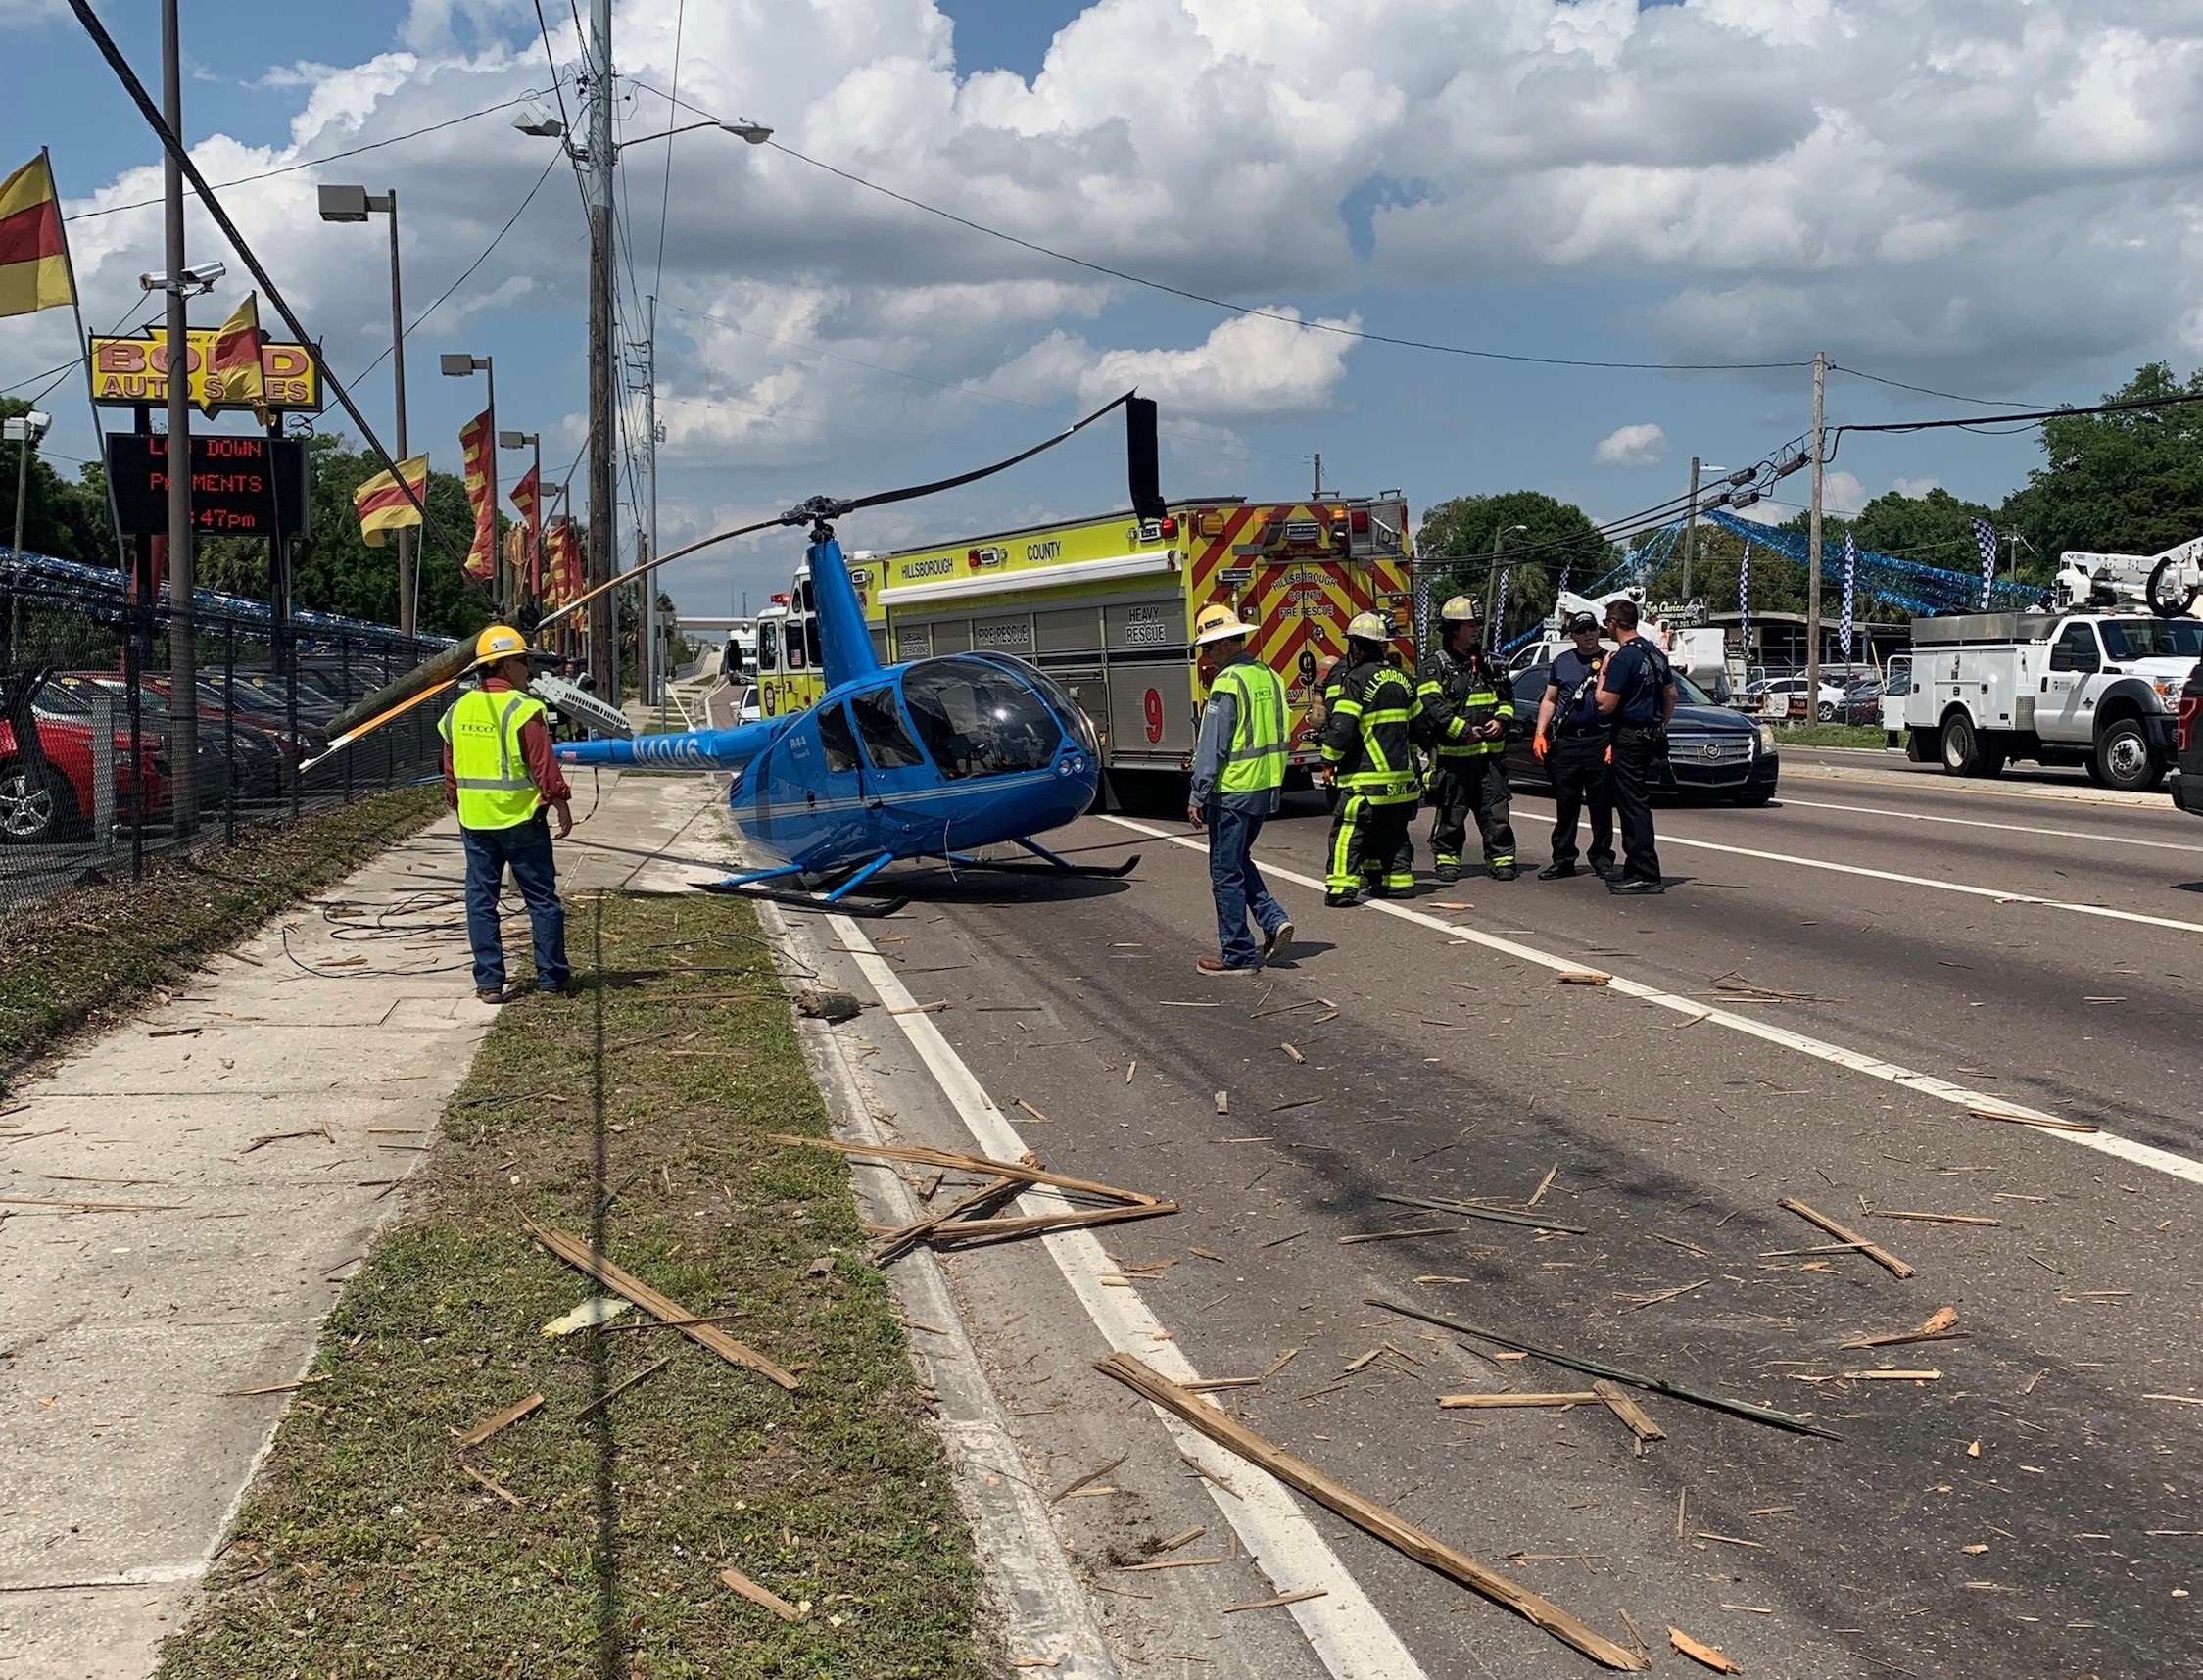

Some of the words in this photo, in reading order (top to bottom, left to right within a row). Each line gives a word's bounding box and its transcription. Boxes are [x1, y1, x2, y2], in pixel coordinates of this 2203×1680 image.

[98, 343, 309, 376] BOD
[102, 376, 192, 397] AUT
[204, 379, 309, 401] SES
[206, 440, 263, 457] DOWN
[150, 473, 263, 493] PMENTS
[900, 557, 954, 580] HILLSBOROUGH
[1027, 540, 1062, 561] COUNTY
[1271, 572, 1338, 592] HILLSBOROUGH
[1287, 589, 1323, 602] COUNTY
[1127, 605, 1160, 623] HEAVY
[1278, 607, 1298, 619] FIRE
[1300, 604, 1335, 617] RESCUE
[978, 626, 995, 646] FIRE
[996, 623, 1029, 644] RESCUE
[1125, 625, 1166, 644] RESCUE
[1298, 650, 1317, 687] 9
[1285, 689, 1305, 700] AVY
[1143, 687, 1164, 744] 9
[460, 723, 494, 734] TECO
[789, 735, 807, 750] R44
